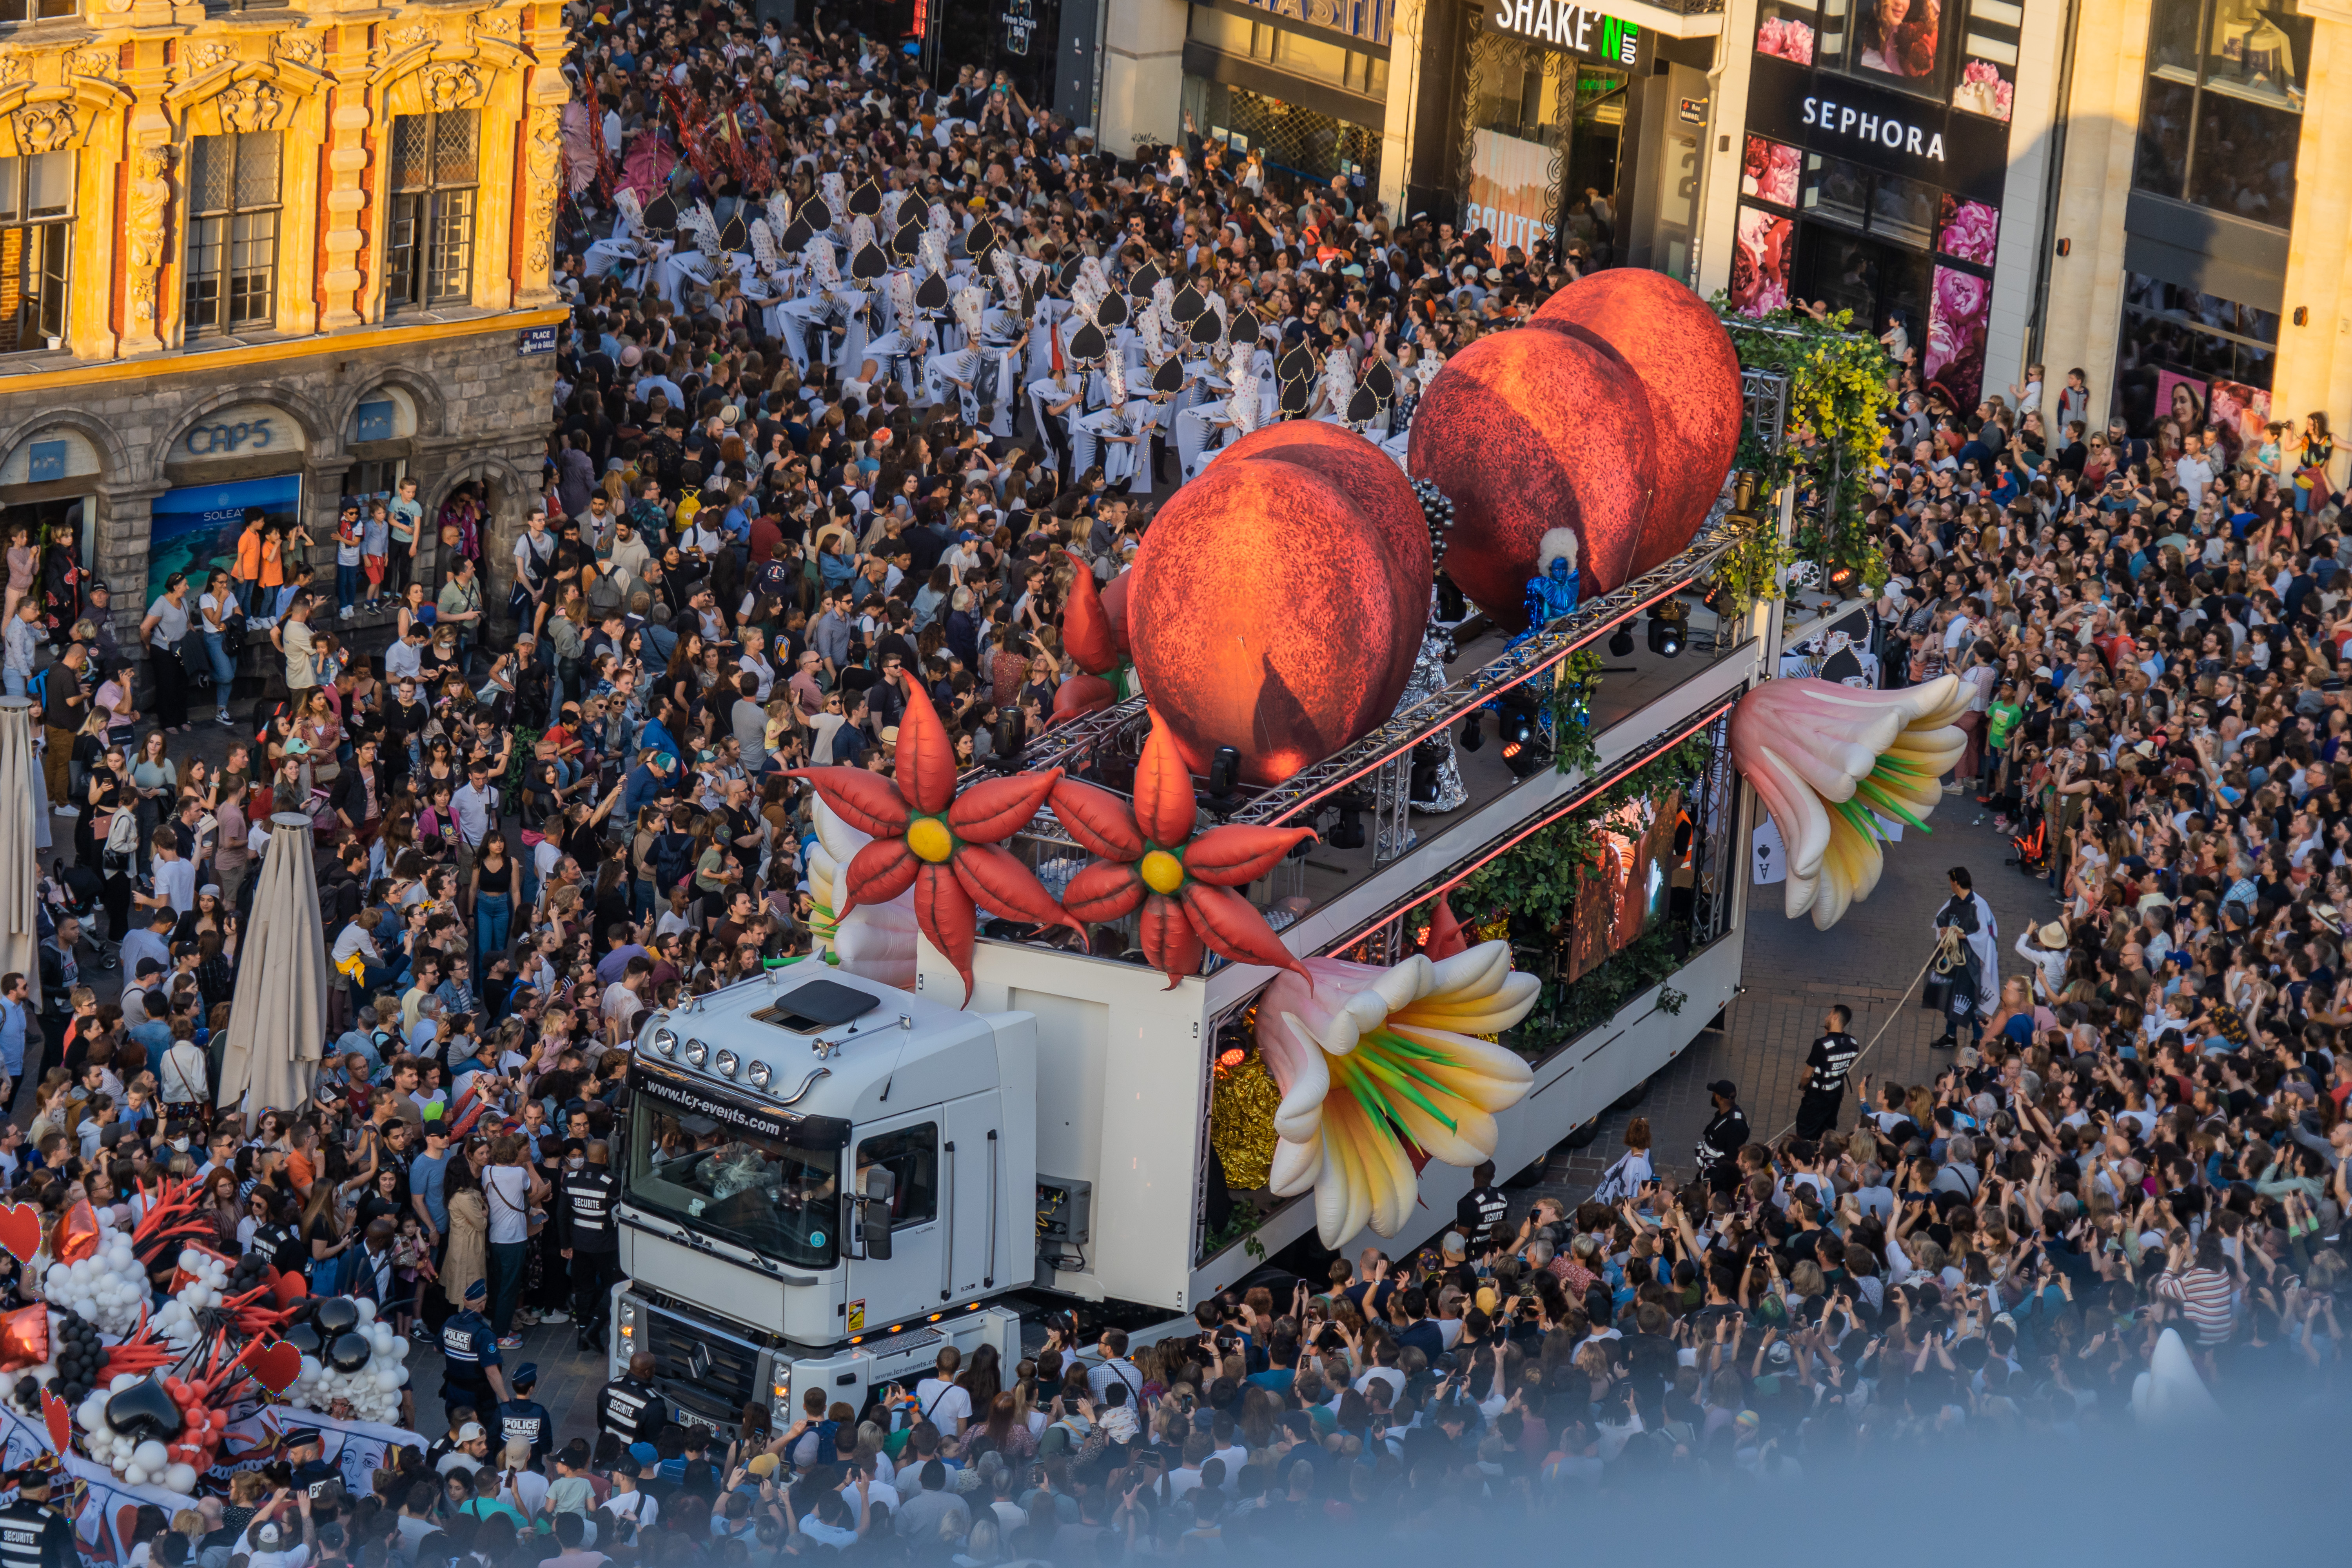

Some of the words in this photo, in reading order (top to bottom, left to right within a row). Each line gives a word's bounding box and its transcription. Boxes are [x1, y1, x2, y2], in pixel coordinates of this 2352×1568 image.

[1002, 13, 1018, 25] Free
[1019, 16, 1036, 29] Days
[1013, 26, 1025, 38] 5G
[1621, 33, 1637, 65] OUT
[1802, 97, 1944, 161] SEPHORA
[1466, 202, 1556, 256] GOUTE
[796, 275, 804, 285] A
[532, 330, 550, 339] PLACE
[543, 340, 555, 348] GAULLE
[188, 424, 249, 454] CAP
[252, 419, 270, 448] 5
[203, 508, 241, 521] SOLEA
[1759, 863, 1770, 880] A
[647, 1080, 780, 1136] www.lcr-events.com
[574, 1197, 599, 1209] SECURITE
[814, 1236, 821, 1245] 5
[444, 1329, 469, 1343] POLICE
[445, 1338, 468, 1349] MUNICIPALE
[875, 1358, 936, 1381] www.lcr-events.co
[610, 1398, 634, 1417] SECURITE
[504, 1419, 538, 1429] POLICE
[4, 1530, 34, 1544] SECURITE
